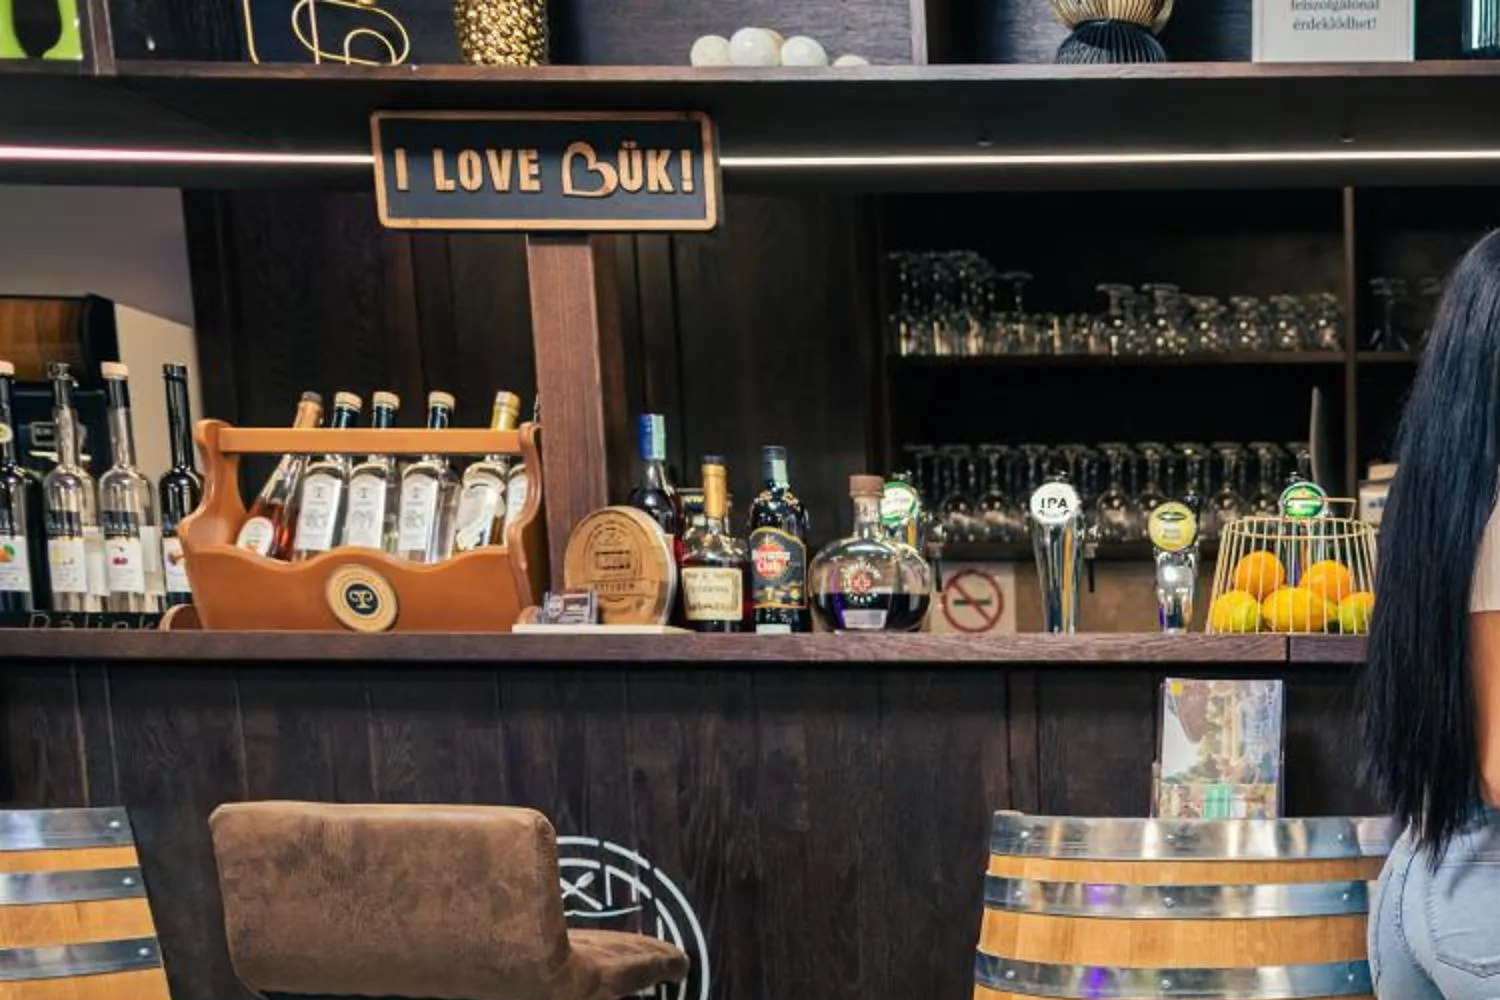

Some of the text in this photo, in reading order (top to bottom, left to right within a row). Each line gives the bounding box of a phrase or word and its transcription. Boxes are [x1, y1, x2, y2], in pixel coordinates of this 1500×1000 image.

[395, 139, 694, 197] I LOVE BÜK!
[1041, 497, 1068, 508] IPA
